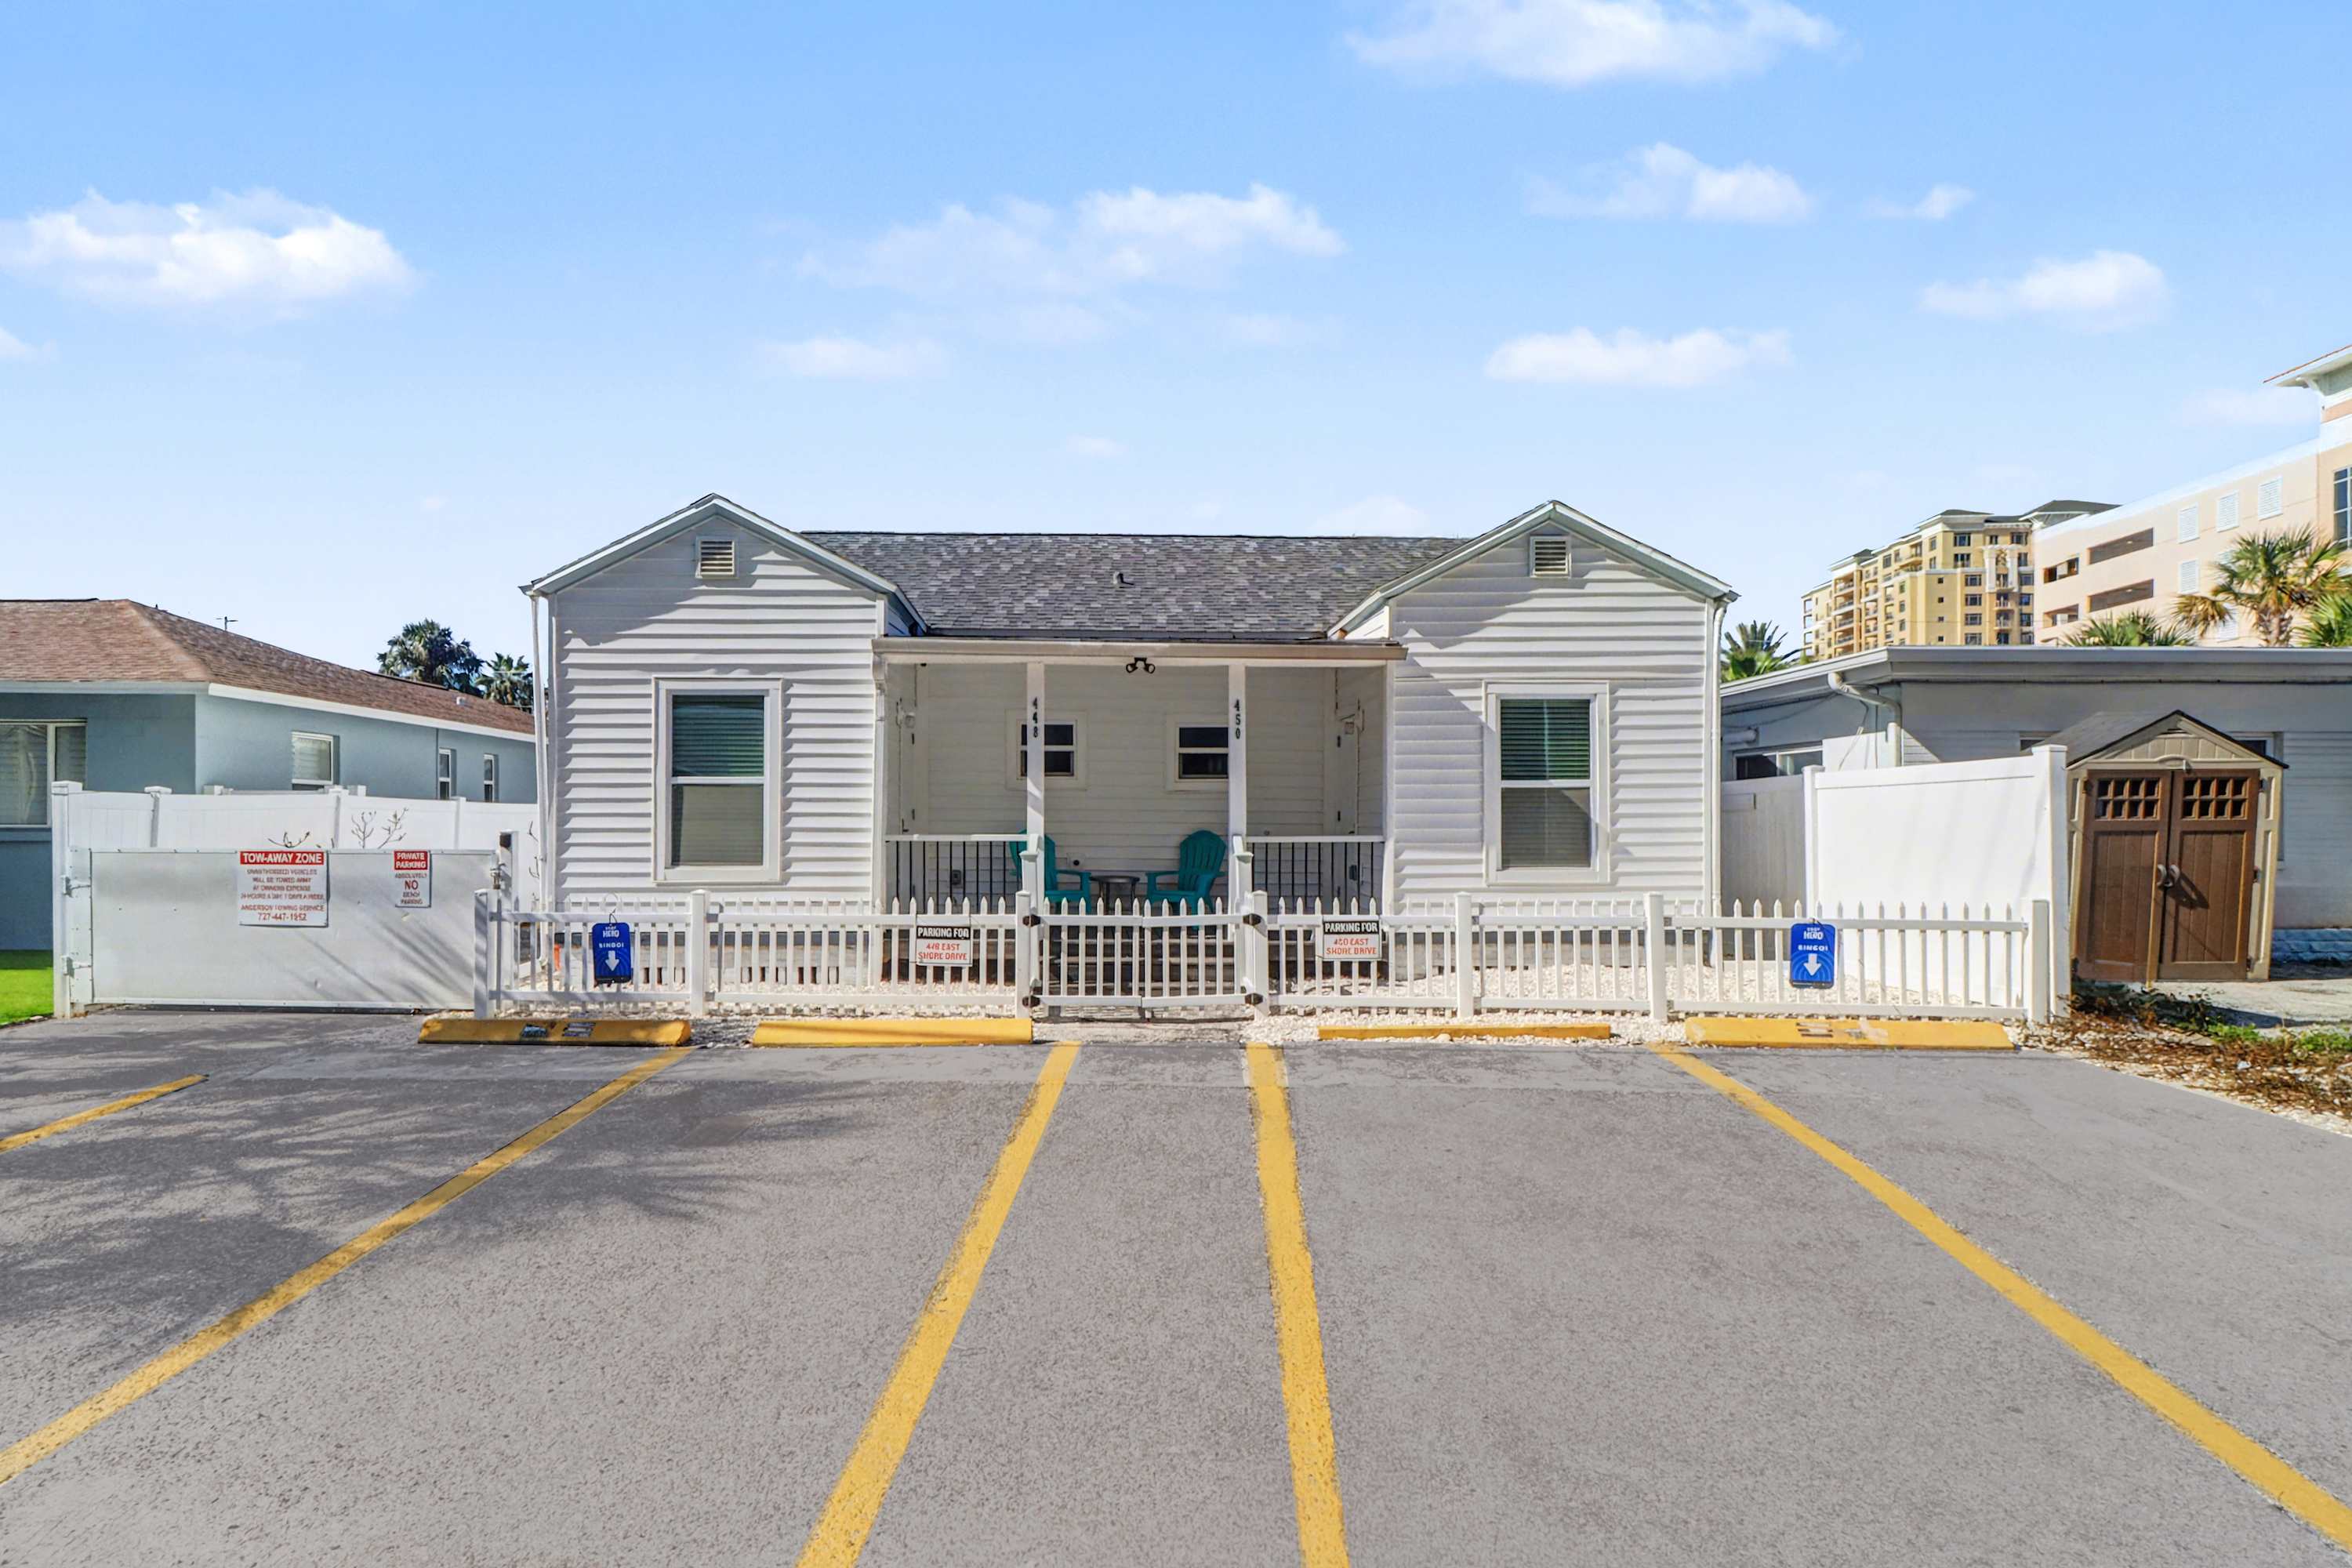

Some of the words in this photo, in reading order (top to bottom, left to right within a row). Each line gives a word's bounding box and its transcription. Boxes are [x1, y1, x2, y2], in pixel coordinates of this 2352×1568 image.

[242, 852, 293, 863] TOW-AWAY
[296, 852, 322, 863] ZONE
[405, 880, 419, 890] NO
[1325, 922, 1360, 932] PARKING
[1361, 922, 1378, 932] FOR
[917, 927, 952, 938] PARKING
[953, 927, 969, 938] FOR
